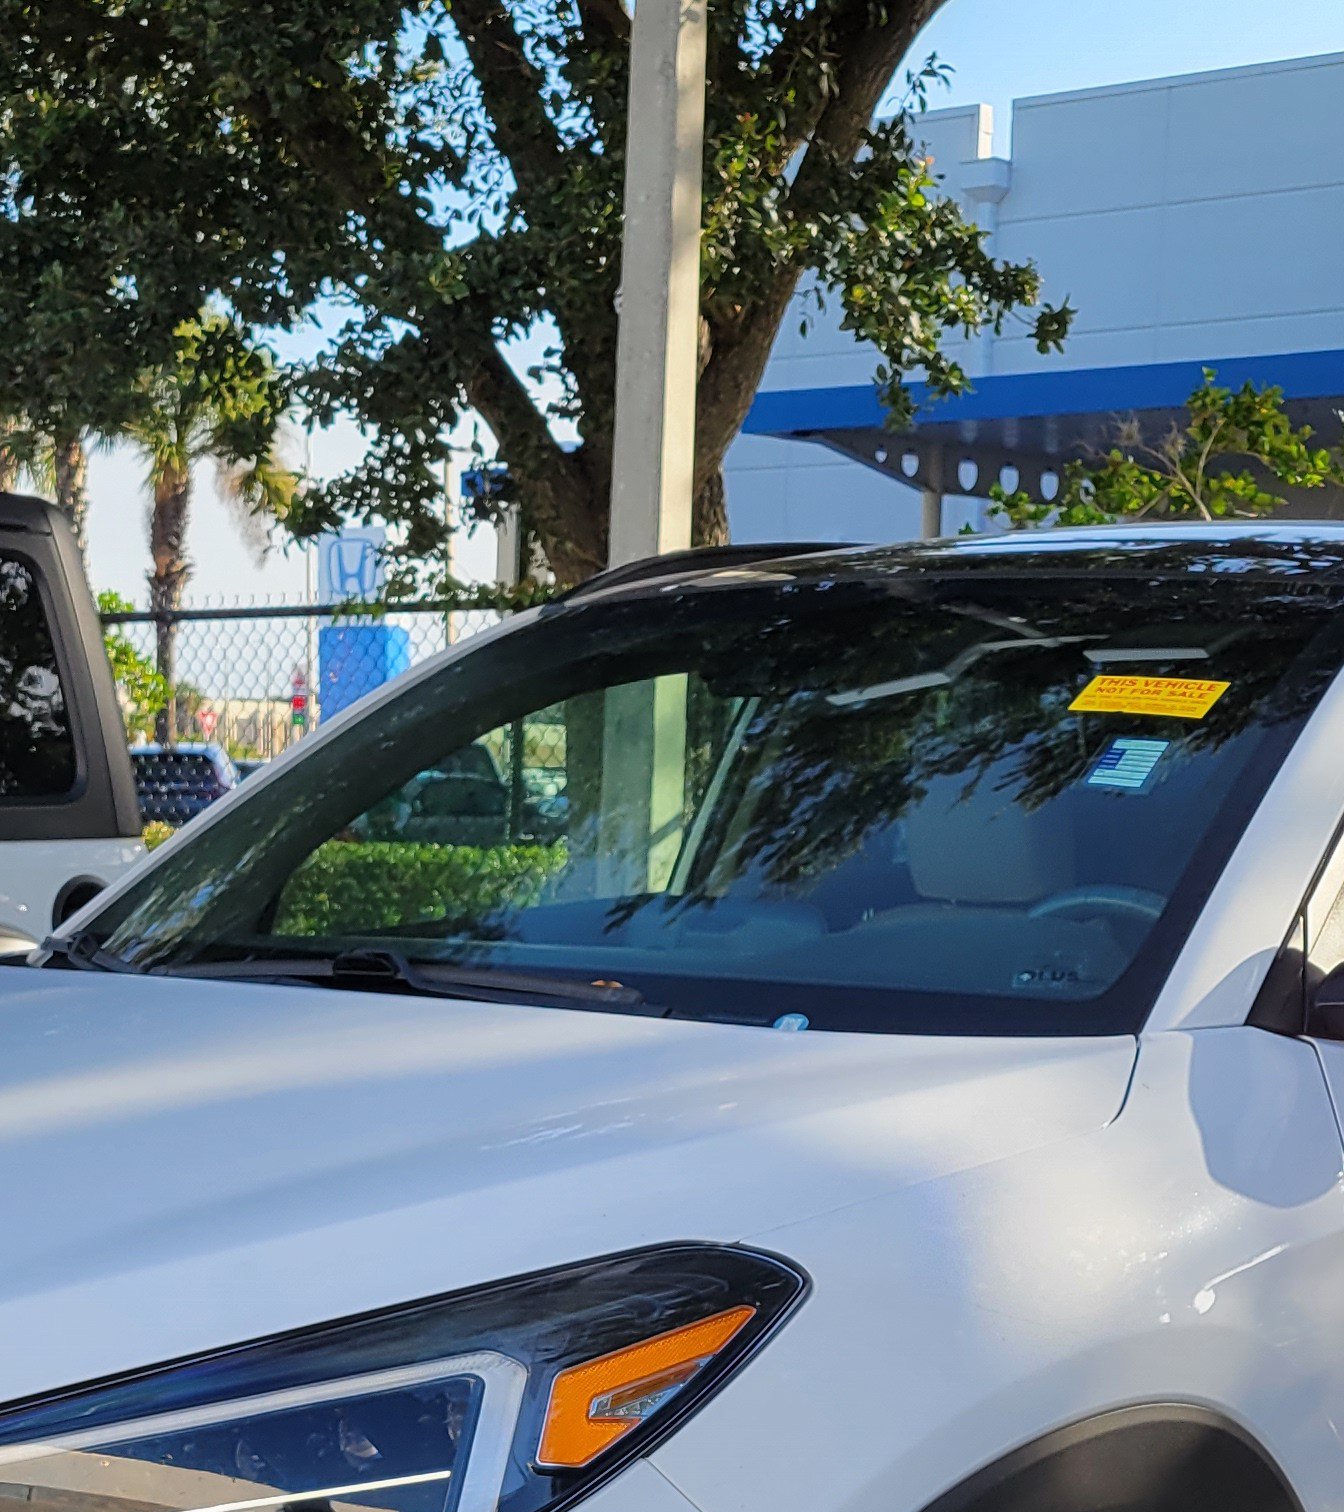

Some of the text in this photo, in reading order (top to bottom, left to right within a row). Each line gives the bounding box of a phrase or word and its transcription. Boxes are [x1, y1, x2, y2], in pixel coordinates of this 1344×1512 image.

[1099, 678, 1219, 692] THIS VEHICLE
[1095, 686, 1207, 700] NOT FOR SALE
